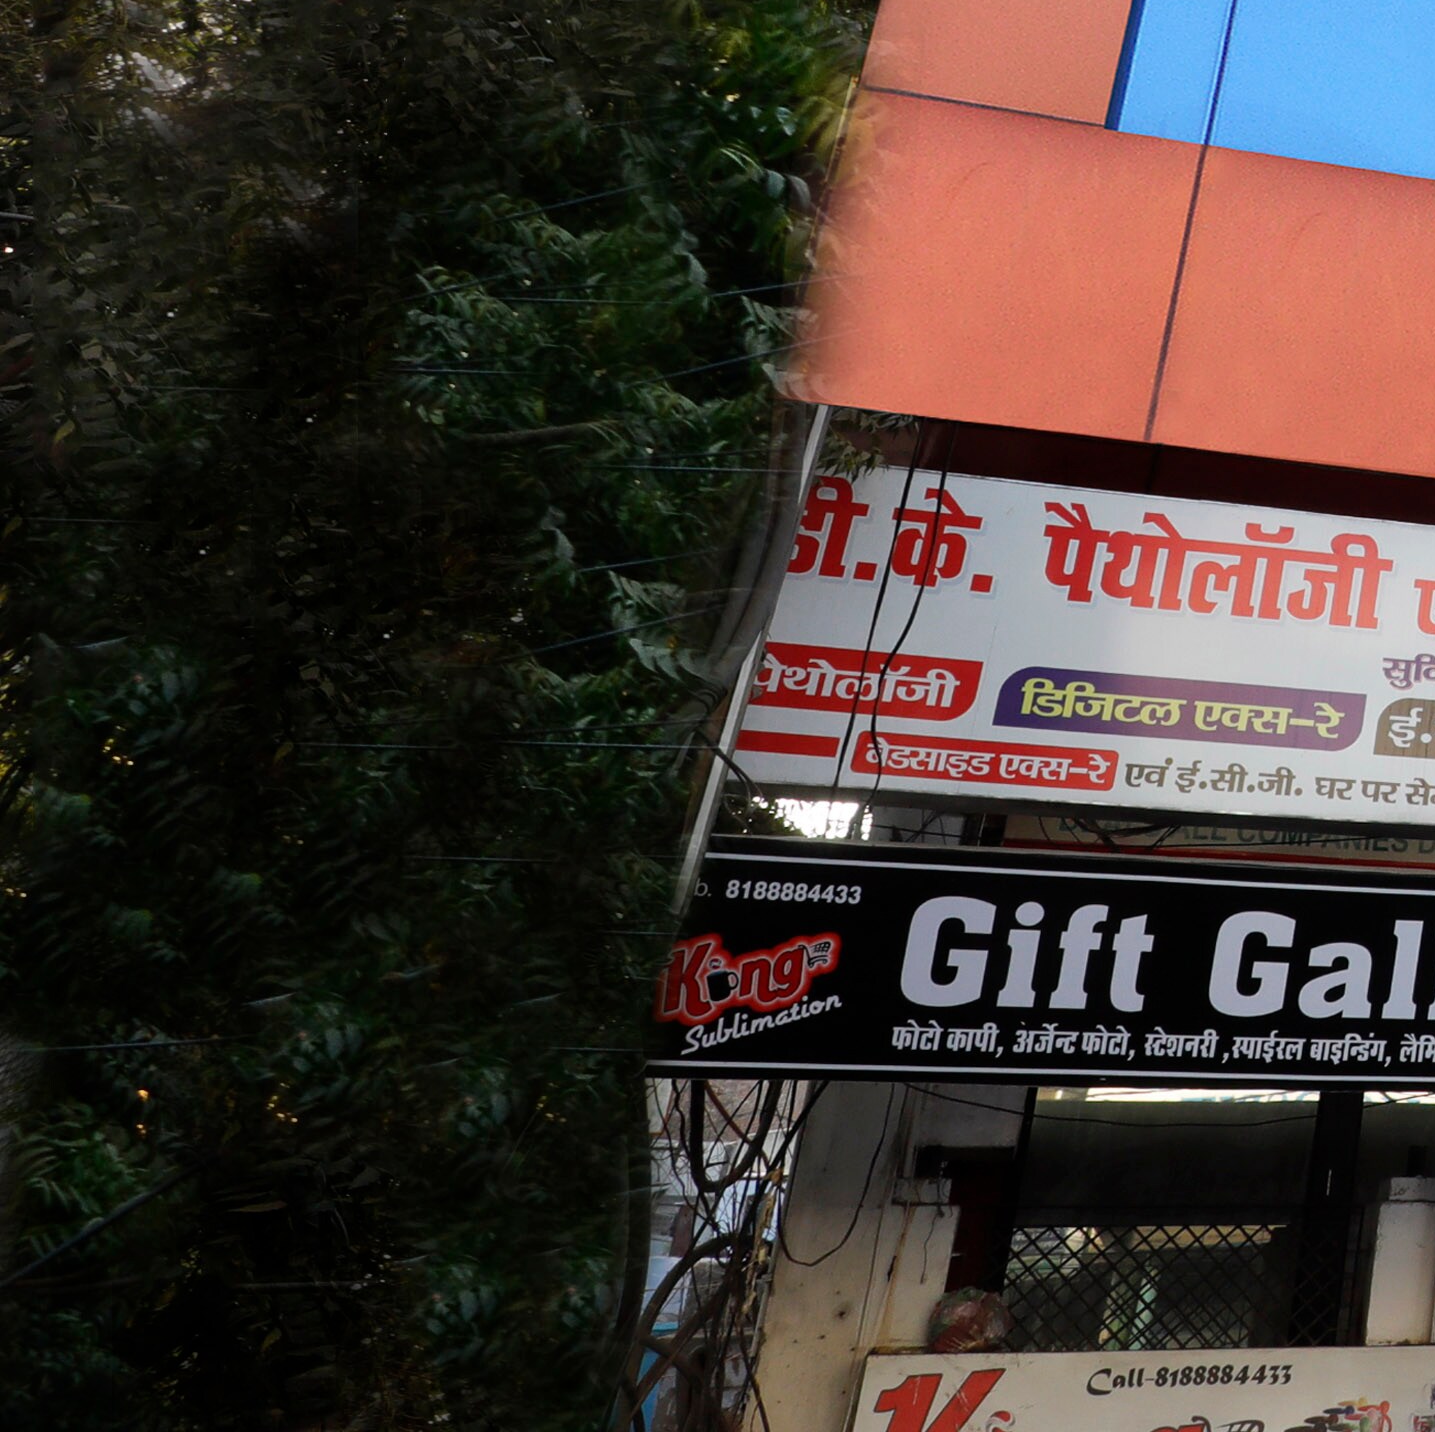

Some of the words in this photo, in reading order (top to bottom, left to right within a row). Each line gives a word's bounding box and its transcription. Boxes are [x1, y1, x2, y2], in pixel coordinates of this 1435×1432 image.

[1044, 502, 1394, 629] पैथोलॉजी
[1021, 677, 1188, 730] डिजिटल
[1194, 700, 1346, 740] एक्स-रे
[999, 745, 1112, 784] एक्स-रे
[1125, 757, 1174, 788] एवं
[1175, 761, 1304, 796] ई.सी.जी.
[1315, 776, 1356, 800] घर
[1361, 780, 1401, 804] पर
[725, 879, 862, 904] 8188884433
[899, 894, 1155, 1014] Gift
[681, 995, 842, 1056] Sublimation
[892, 1020, 943, 1051] फोटो
[946, 1022, 1004, 1058] कापी,
[1082, 1025, 1136, 1062] फोटो,
[1144, 1027, 1219, 1059] स्टेशनरी
[1086, 1363, 1293, 1396] Call-8188884433
